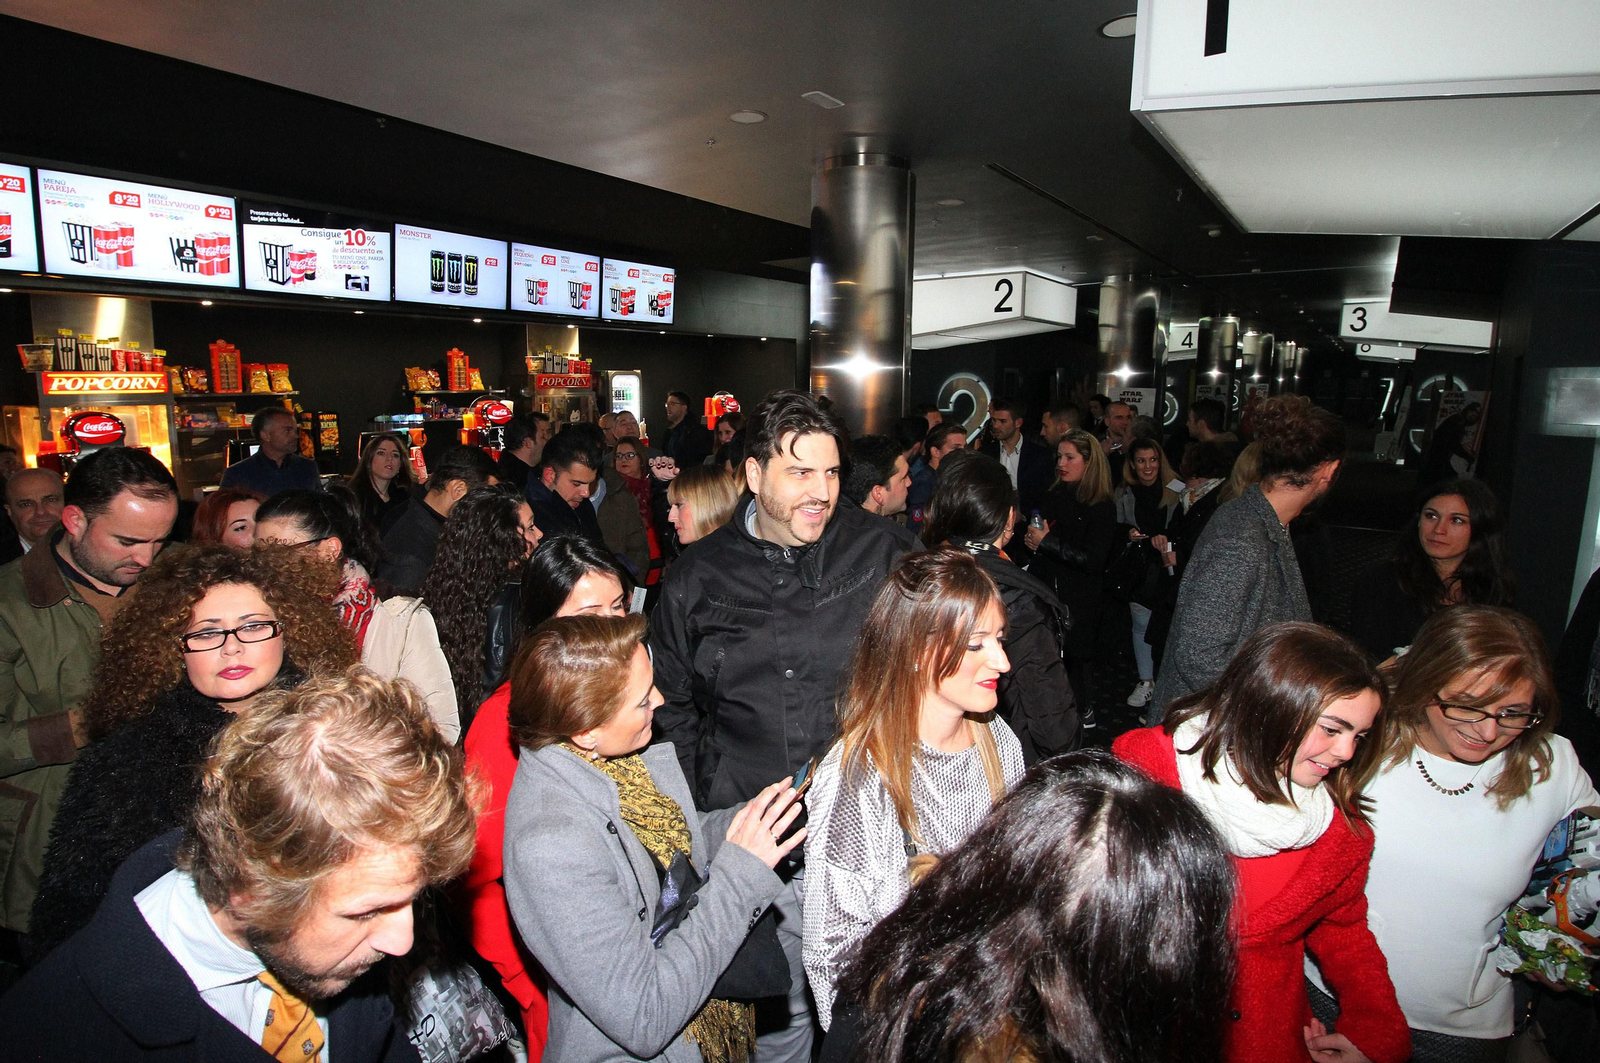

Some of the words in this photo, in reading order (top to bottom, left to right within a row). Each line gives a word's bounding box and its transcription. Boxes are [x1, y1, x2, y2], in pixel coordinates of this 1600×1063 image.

[43, 184, 77, 194] PAREJA
[148, 198, 201, 211] HOLLYWOOD
[300, 229, 342, 240] Consigue
[399, 229, 432, 240] MONSTER
[340, 246, 376, 255] descuento
[993, 278, 1014, 313] 2
[1349, 306, 1367, 333] 3
[1181, 331, 1194, 349] 4
[49, 376, 162, 391] POPCORN
[541, 377, 589, 387] POPCORN
[82, 421, 114, 433] Coca-Cola
